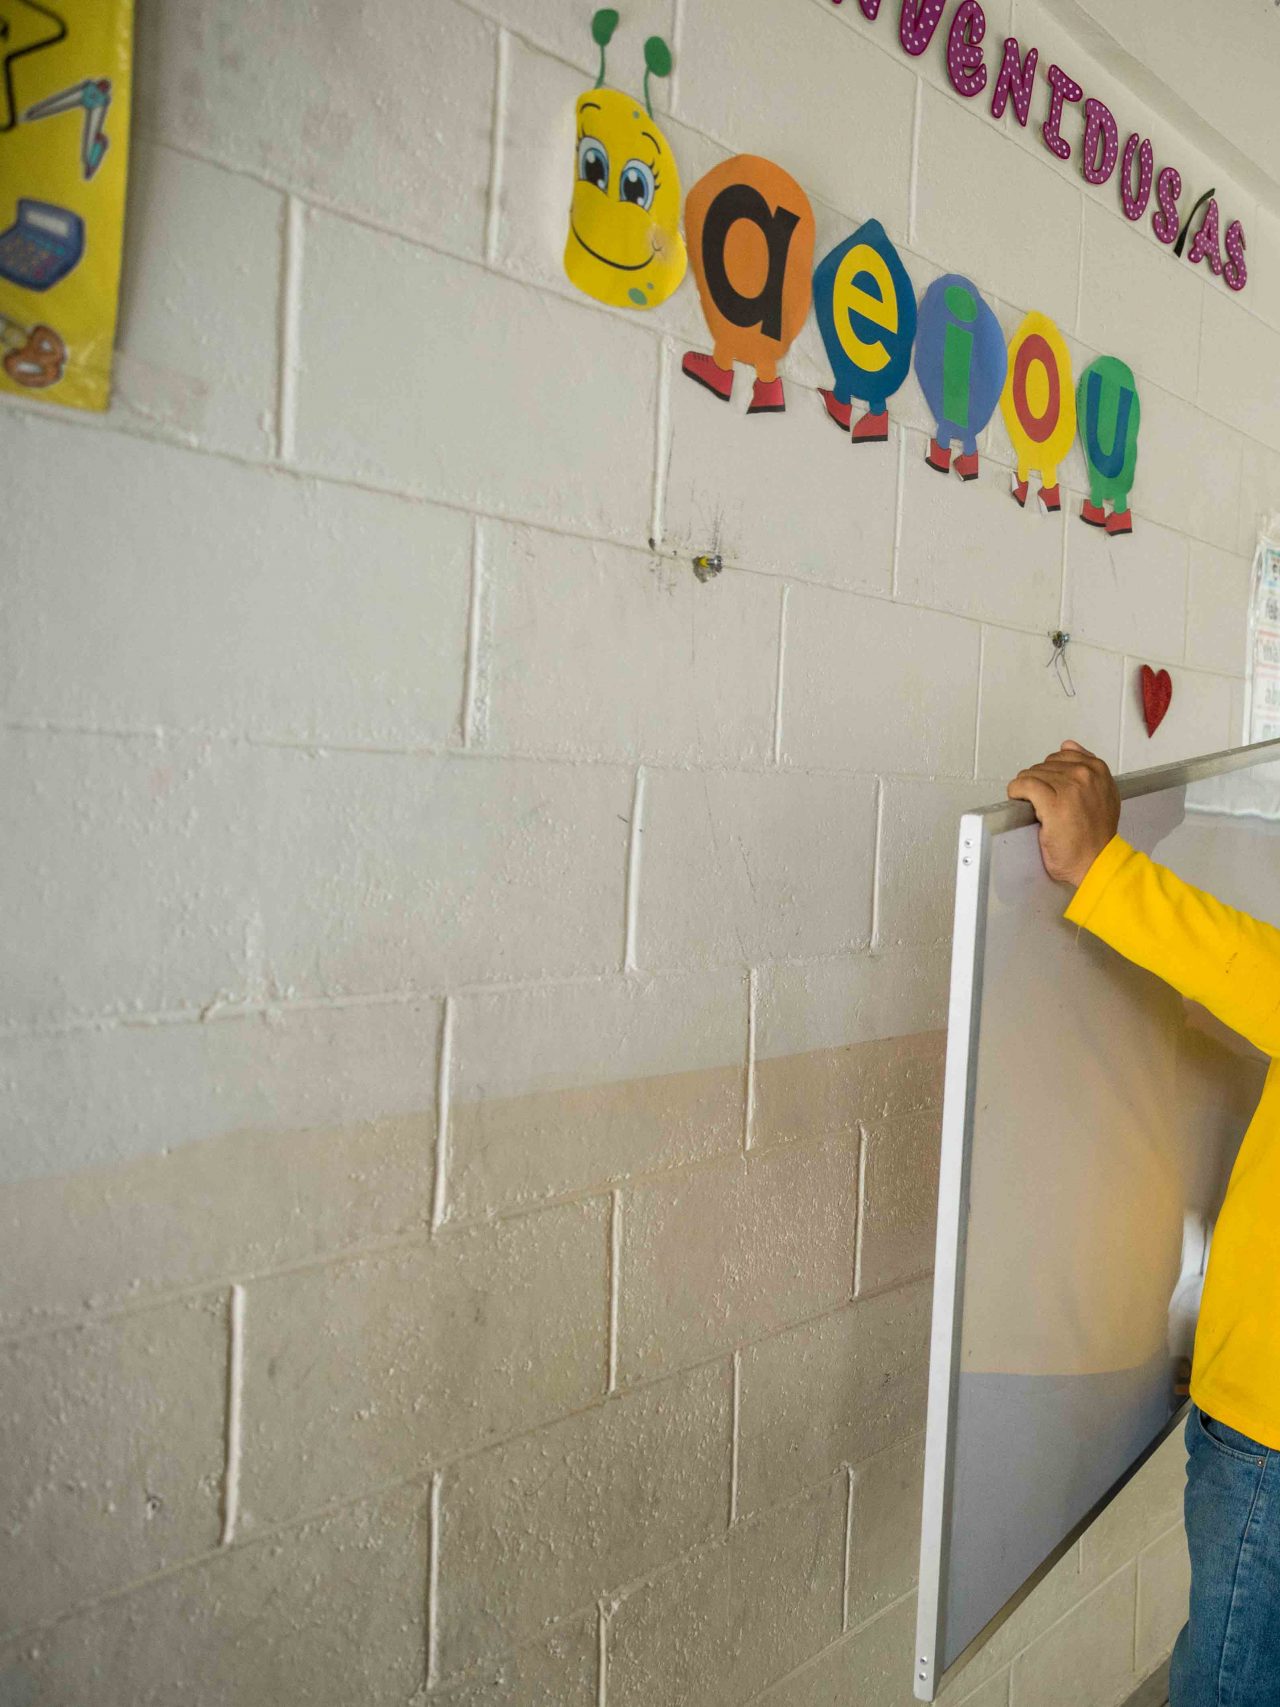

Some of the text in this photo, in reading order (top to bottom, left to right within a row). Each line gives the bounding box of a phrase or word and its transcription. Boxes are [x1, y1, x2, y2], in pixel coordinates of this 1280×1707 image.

[702, 184, 800, 341] a
[833, 243, 898, 372] e
[943, 285, 978, 429] i
[1013, 333, 1060, 443] o
